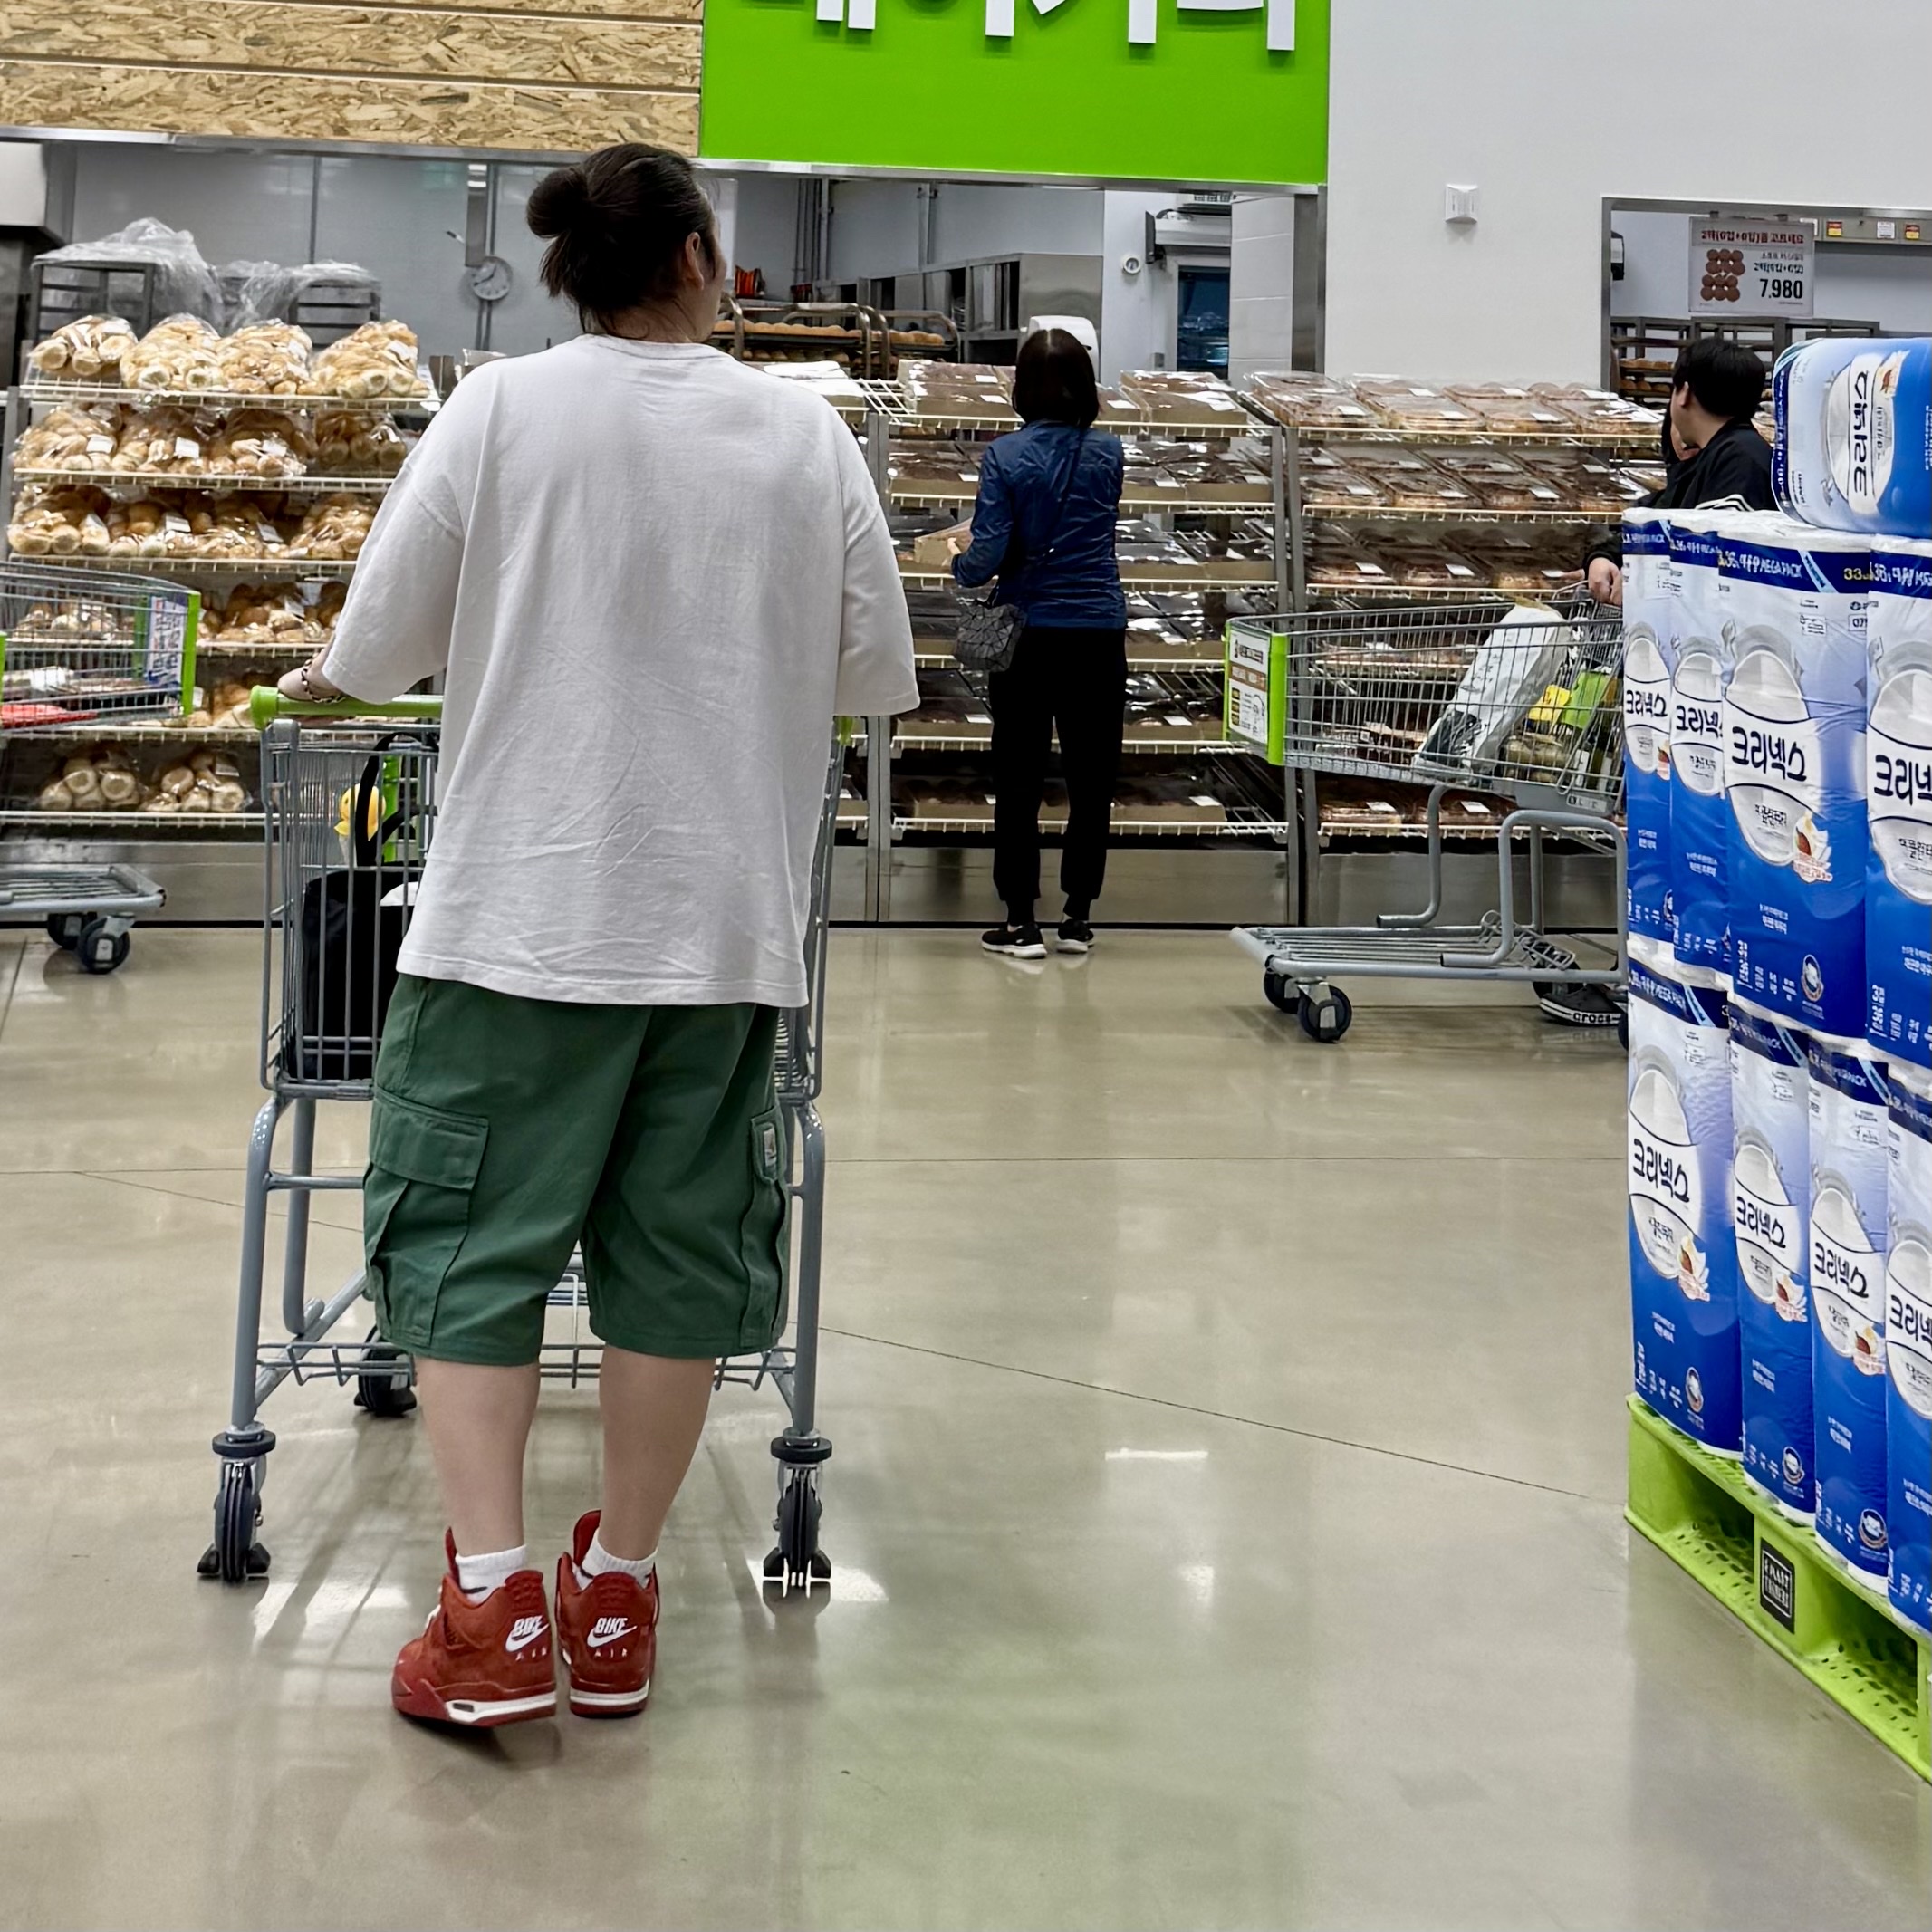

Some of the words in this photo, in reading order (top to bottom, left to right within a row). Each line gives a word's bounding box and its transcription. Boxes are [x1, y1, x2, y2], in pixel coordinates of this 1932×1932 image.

[1676, 705, 1723, 739] 크리넥
[1731, 726, 1807, 782] 크리넥스
[1633, 1138, 1690, 1203] 크리넥스
[1736, 1196, 1786, 1249] 크리넥스
[1814, 1242, 1870, 1299] 크리넥스
